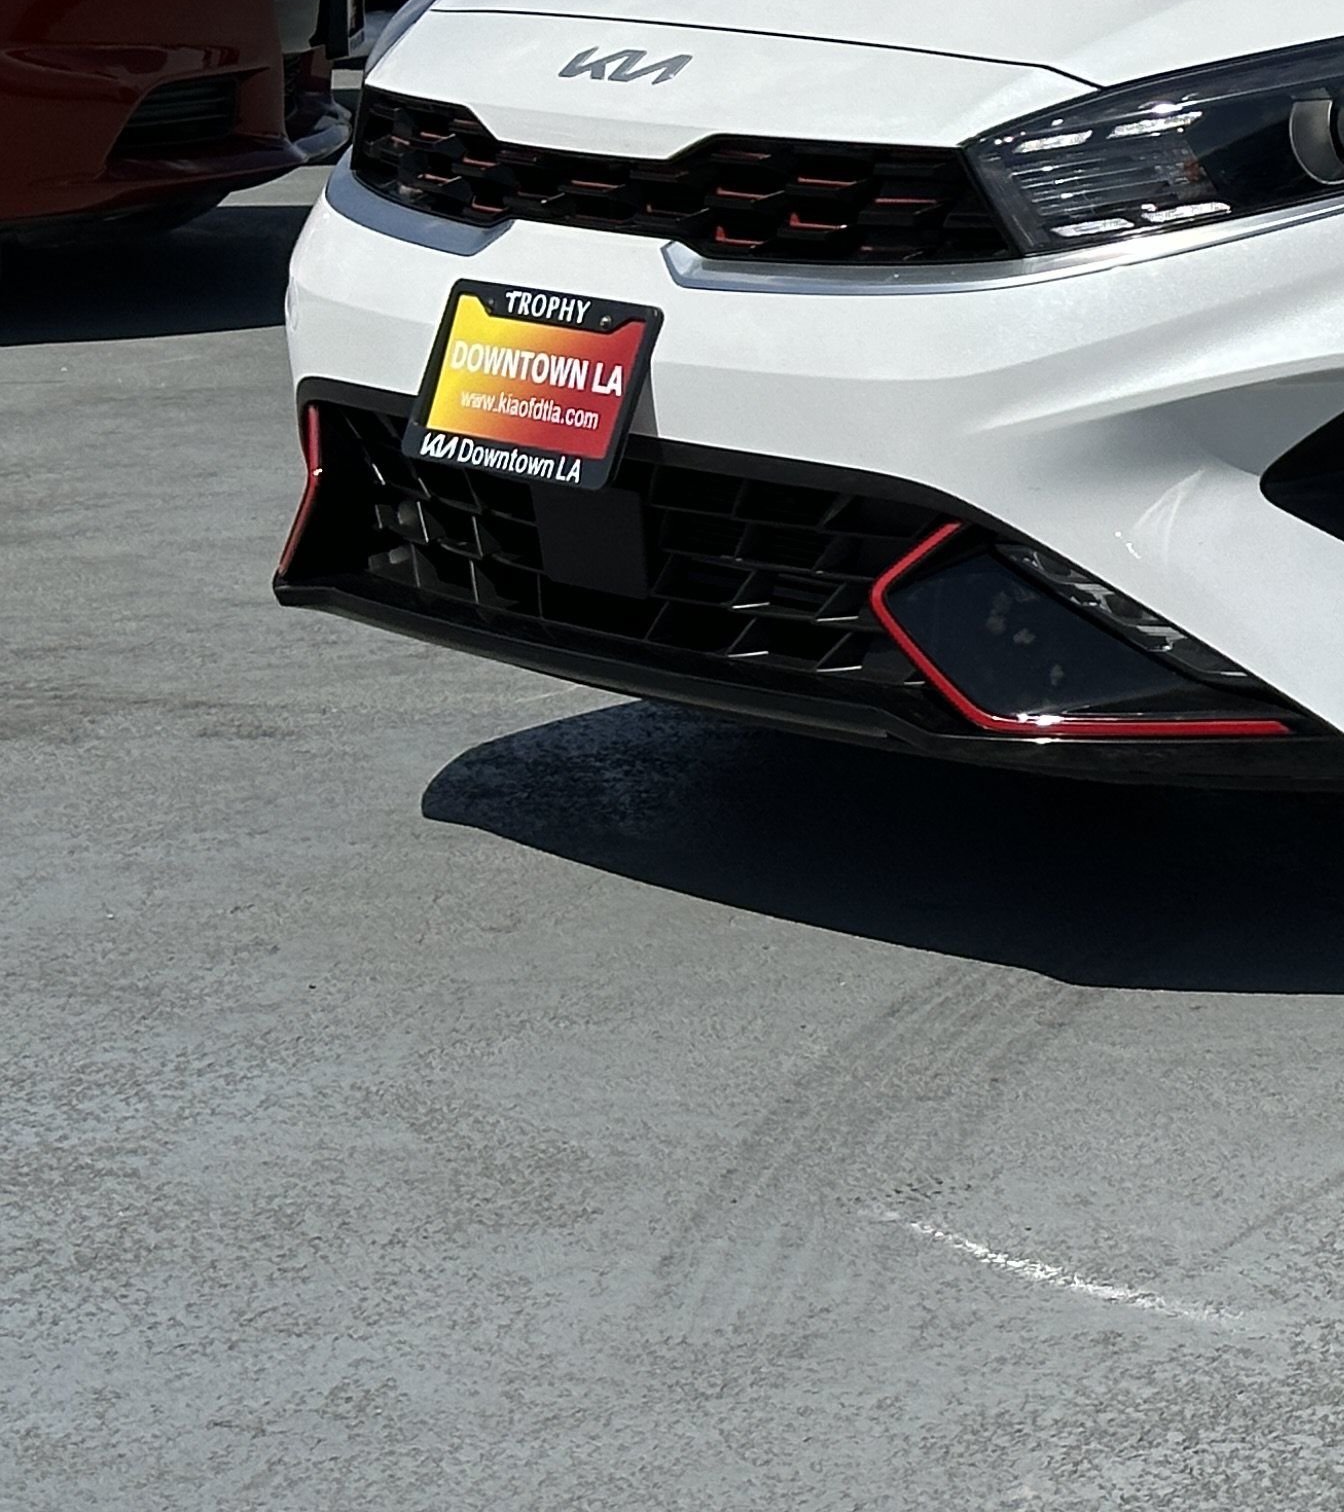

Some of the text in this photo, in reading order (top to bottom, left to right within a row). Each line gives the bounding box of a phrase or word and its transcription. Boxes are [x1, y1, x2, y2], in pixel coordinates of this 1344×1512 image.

[558, 45, 693, 85] KIA
[505, 290, 591, 323] TROPHY
[451, 341, 624, 396] DOWNTOWN LA
[460, 391, 599, 429] www.kiaofdtla.com
[420, 432, 582, 483] KIA Downtown LA
